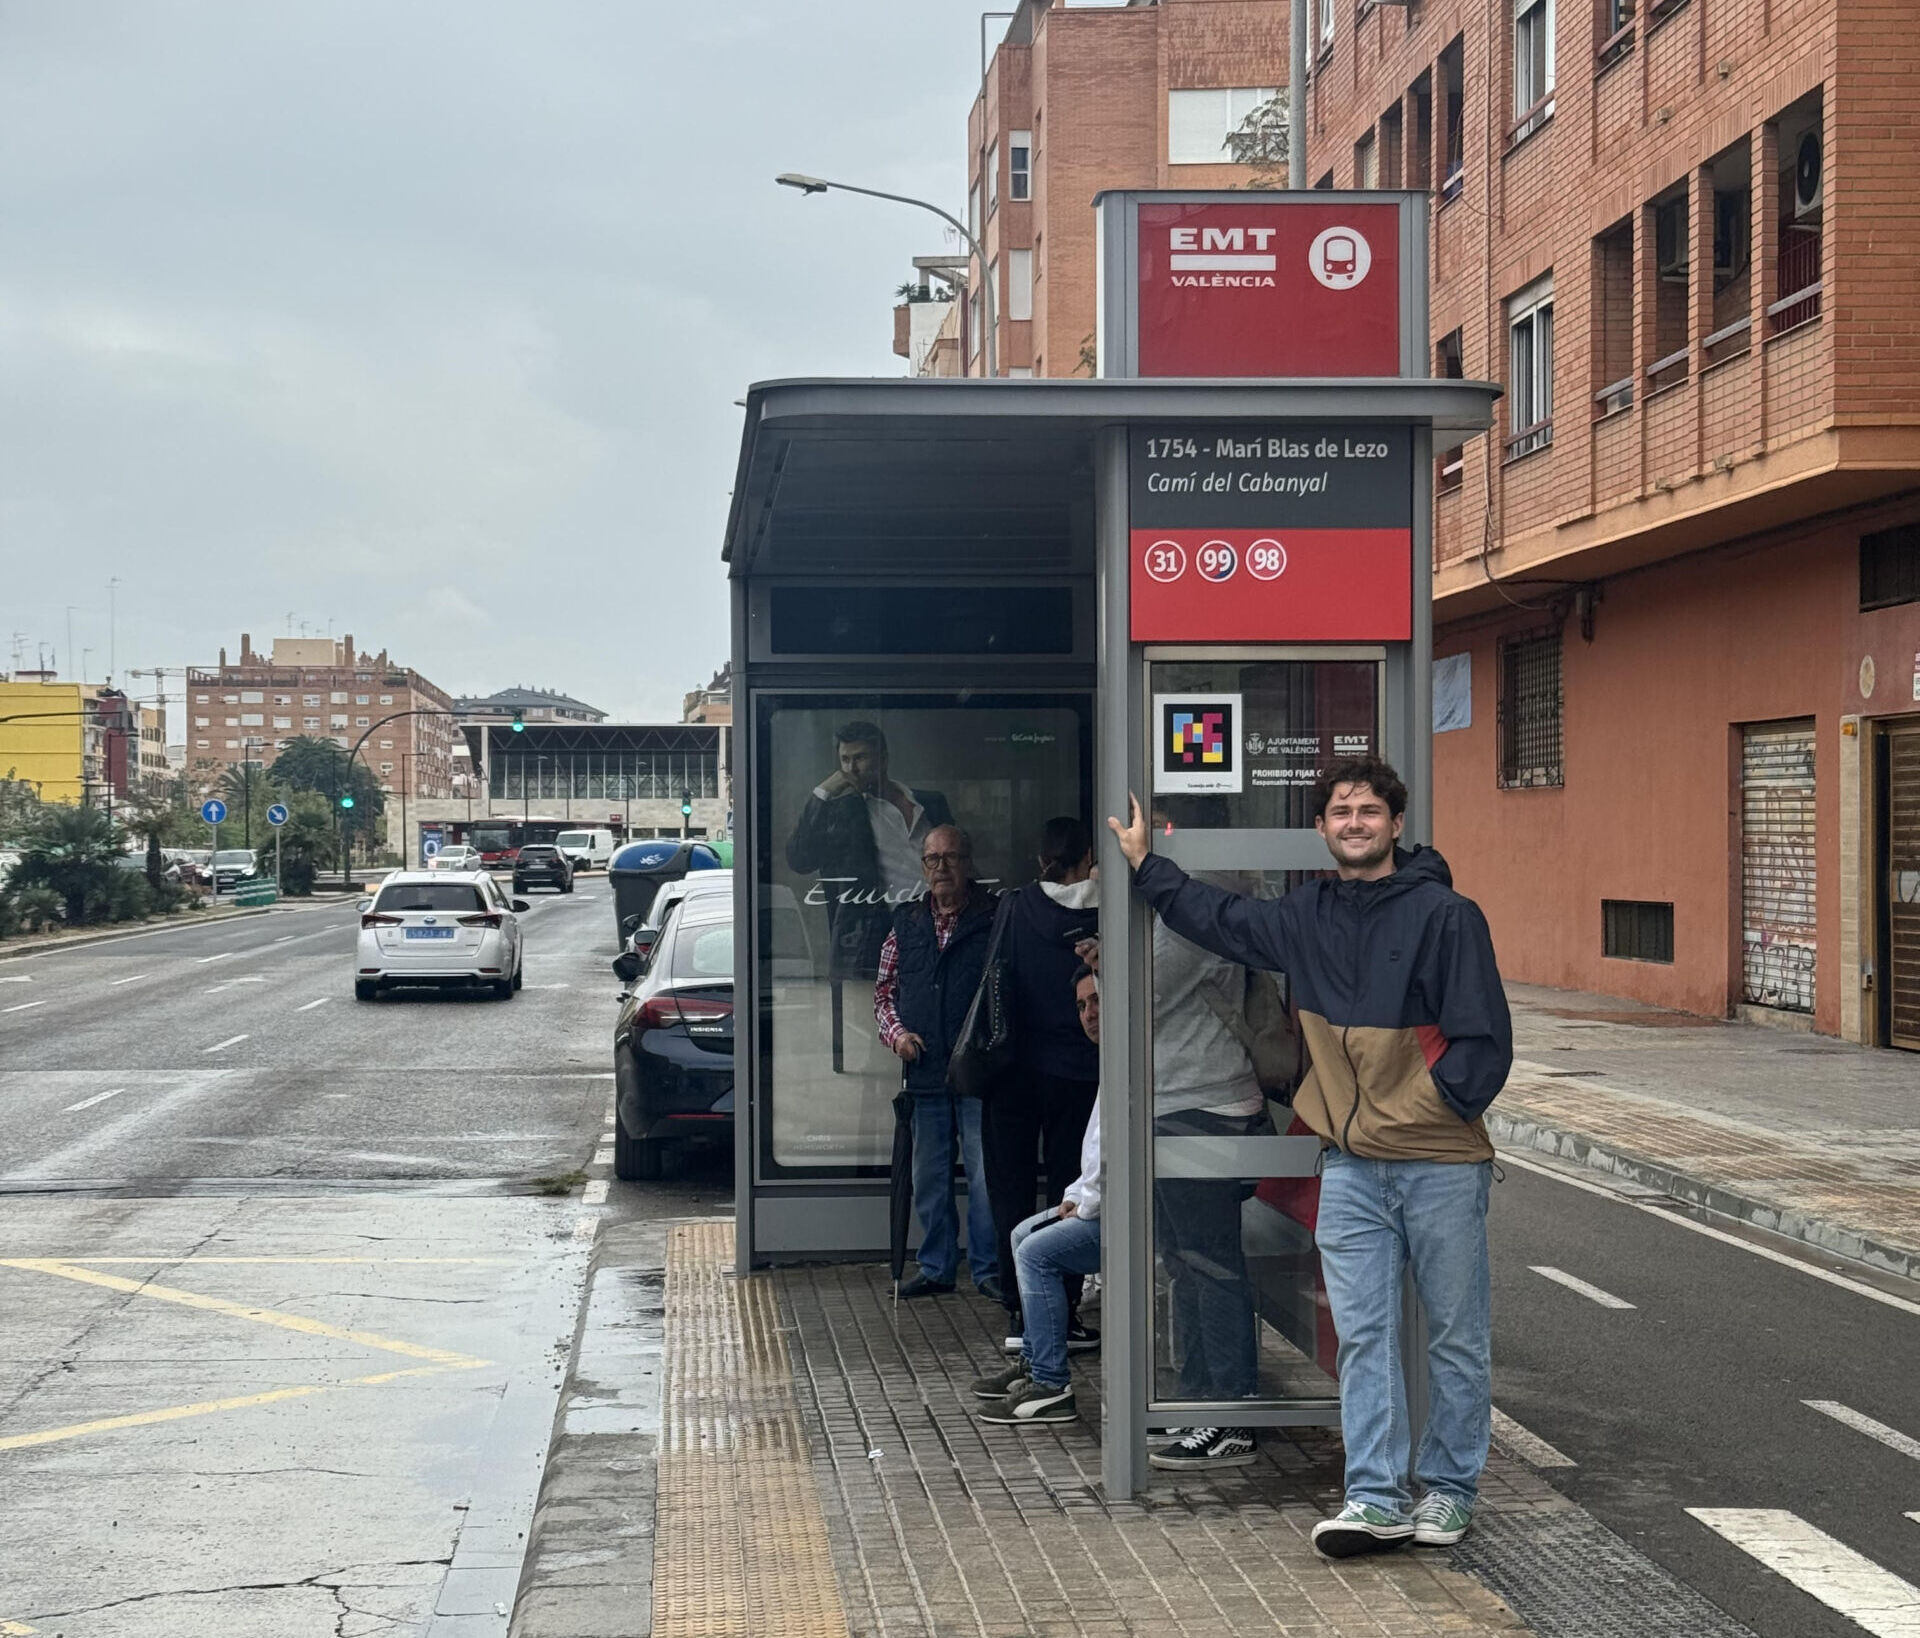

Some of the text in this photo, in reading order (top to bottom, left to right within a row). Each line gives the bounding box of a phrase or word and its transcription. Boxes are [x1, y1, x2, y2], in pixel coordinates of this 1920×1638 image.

[1170, 227, 1276, 251] EMT
[1171, 273, 1276, 288] VALÈNCIA
[1147, 438, 1198, 459] 1754
[1215, 437, 1262, 459] Marí
[1267, 438, 1310, 459] Blas
[1314, 438, 1339, 459] de
[1344, 438, 1389, 459] Lezo
[1147, 471, 1329, 498] Camí del Cabanyal
[1152, 547, 1280, 573] 31 99 98
[1267, 737, 1320, 746] AJUNTAMENT
[1333, 735, 1369, 744] EMT
[1266, 746, 1279, 755] DE
[1251, 769, 1293, 778] PROHIBIDO
